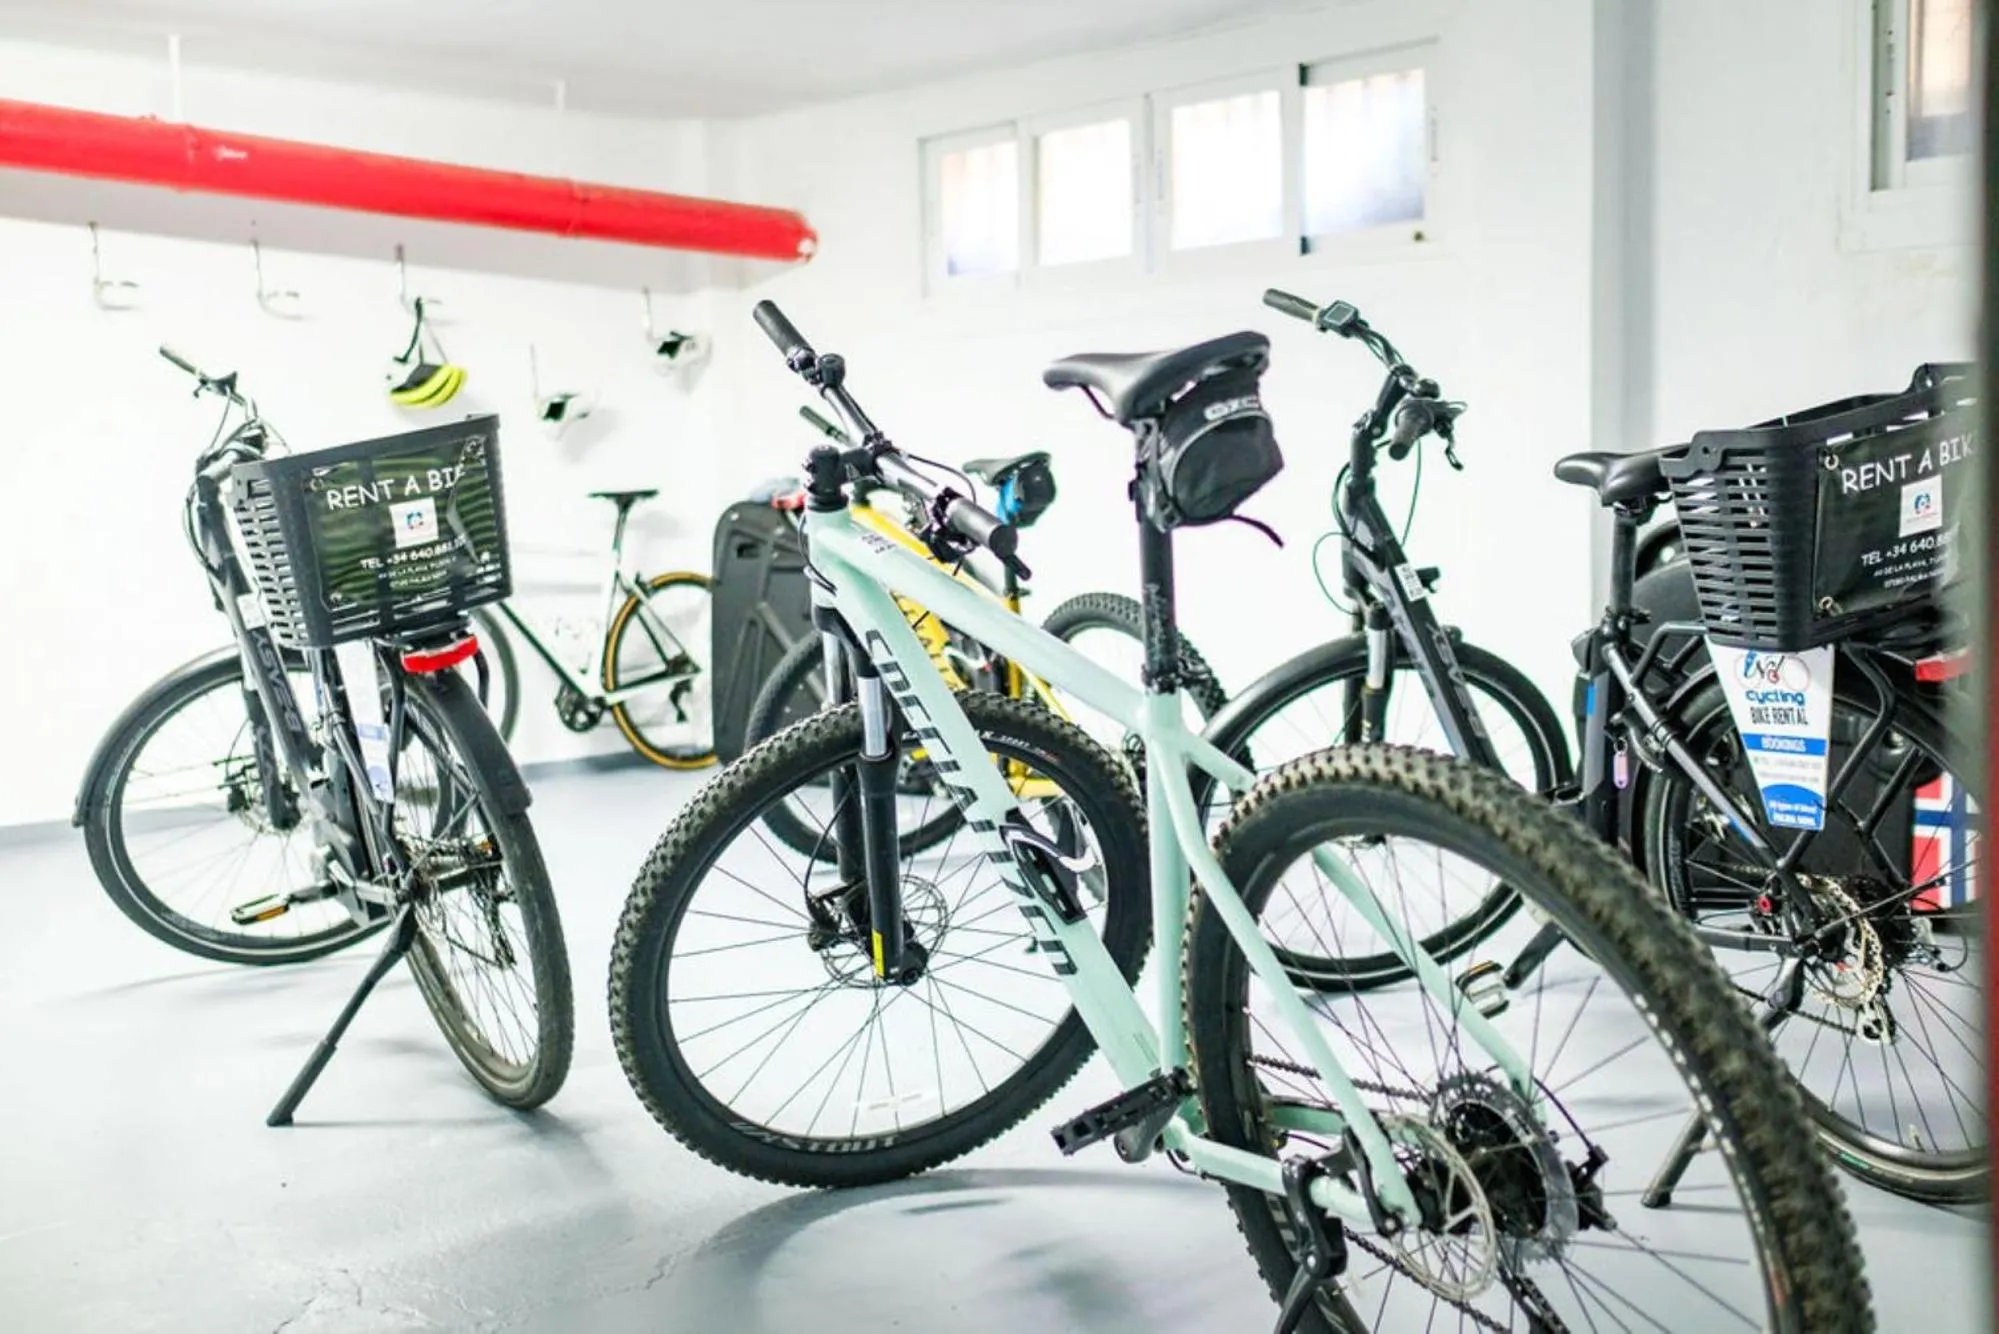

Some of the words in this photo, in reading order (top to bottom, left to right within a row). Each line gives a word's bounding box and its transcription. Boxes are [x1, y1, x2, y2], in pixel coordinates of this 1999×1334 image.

[1841, 454, 1912, 495] RENT
[1918, 449, 1933, 474] A
[325, 479, 396, 511] RENT
[404, 475, 422, 497] A
[360, 557, 385, 571] TEL
[1860, 551, 1883, 567] TEL
[1745, 689, 1805, 706] cycling
[1750, 706, 1772, 726] BIKE
